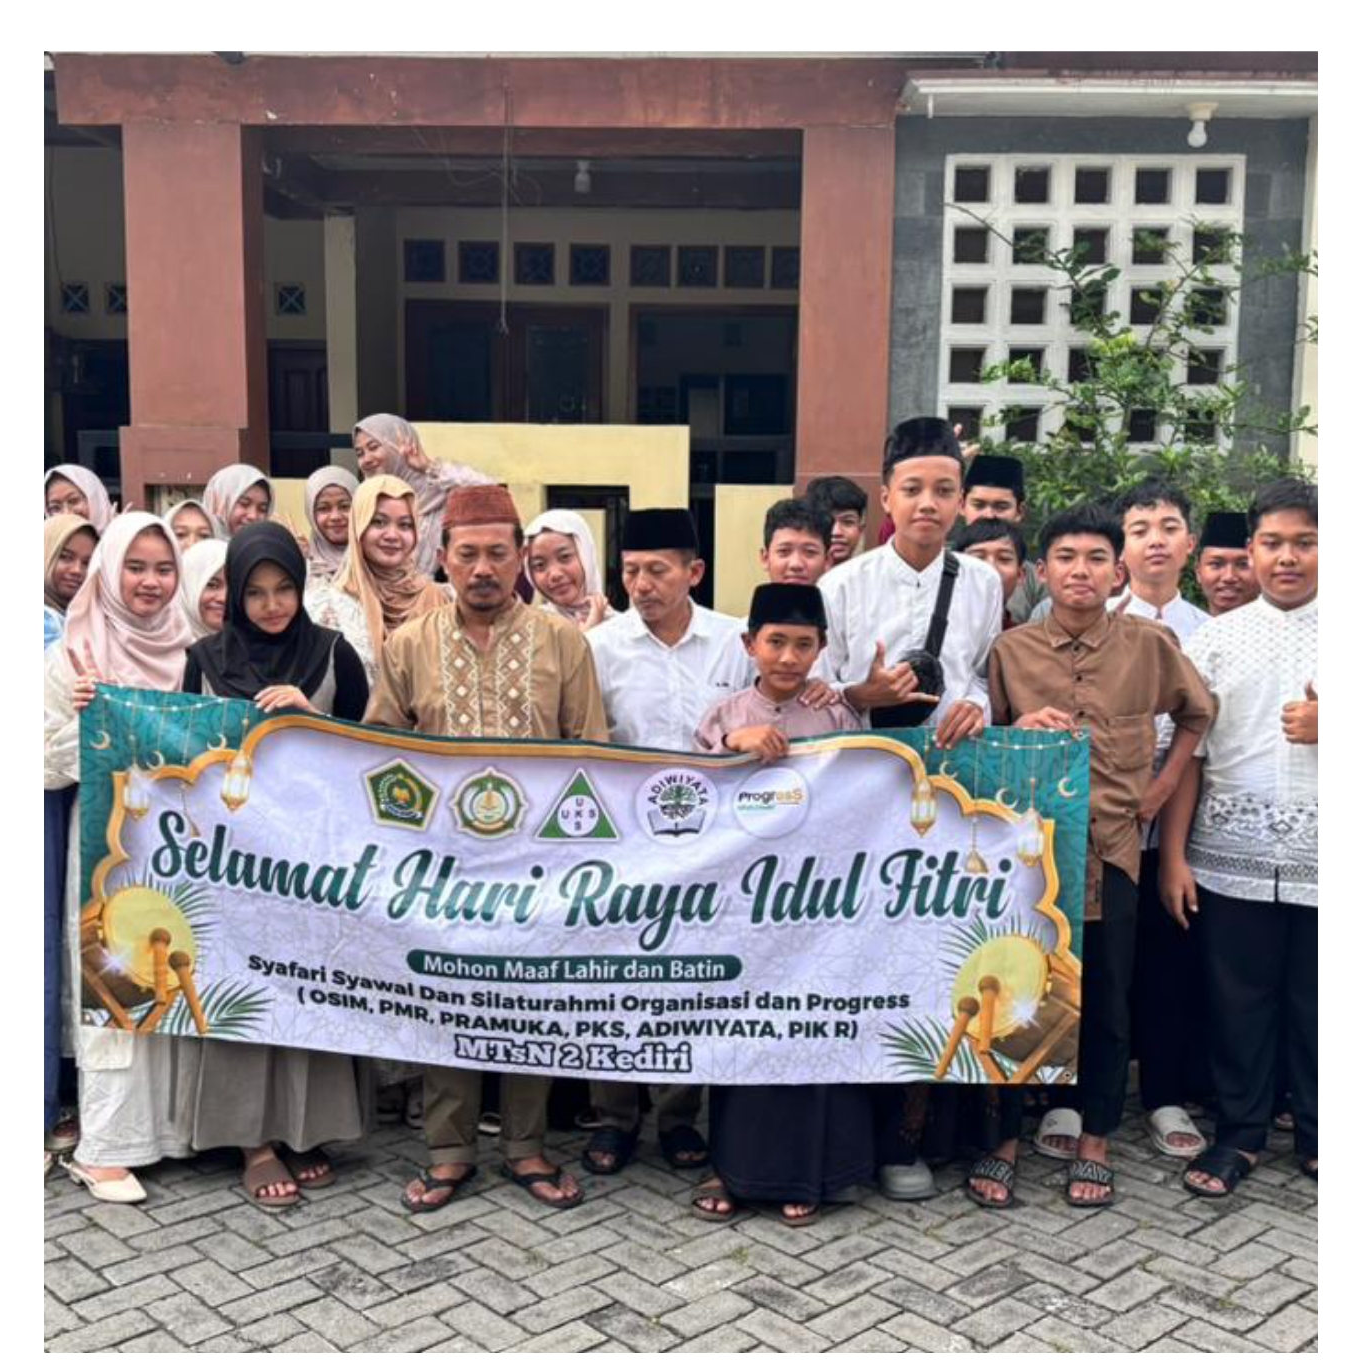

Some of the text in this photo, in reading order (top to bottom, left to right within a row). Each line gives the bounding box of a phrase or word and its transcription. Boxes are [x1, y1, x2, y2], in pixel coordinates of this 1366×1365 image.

[647, 774, 709, 806] ADIWIYATA
[151, 810, 1013, 951] Selamat Hari Raya Idul Fitri
[248, 954, 910, 1017] Syafari Syawal Dan Silaturahmi Organisasi dan Progress
[423, 955, 726, 980] Mohon Maaf Lahir dan Batin
[379, 1000, 435, 1025] PMR,
[439, 1011, 571, 1039] PRAMUKA,
[575, 1019, 632, 1041] PKS,
[636, 1019, 784, 1041] ADIWIYATA,
[788, 1020, 830, 1039] PIK
[833, 1019, 859, 1042] R)
[454, 1034, 693, 1072] MTsN 2 Kediri
